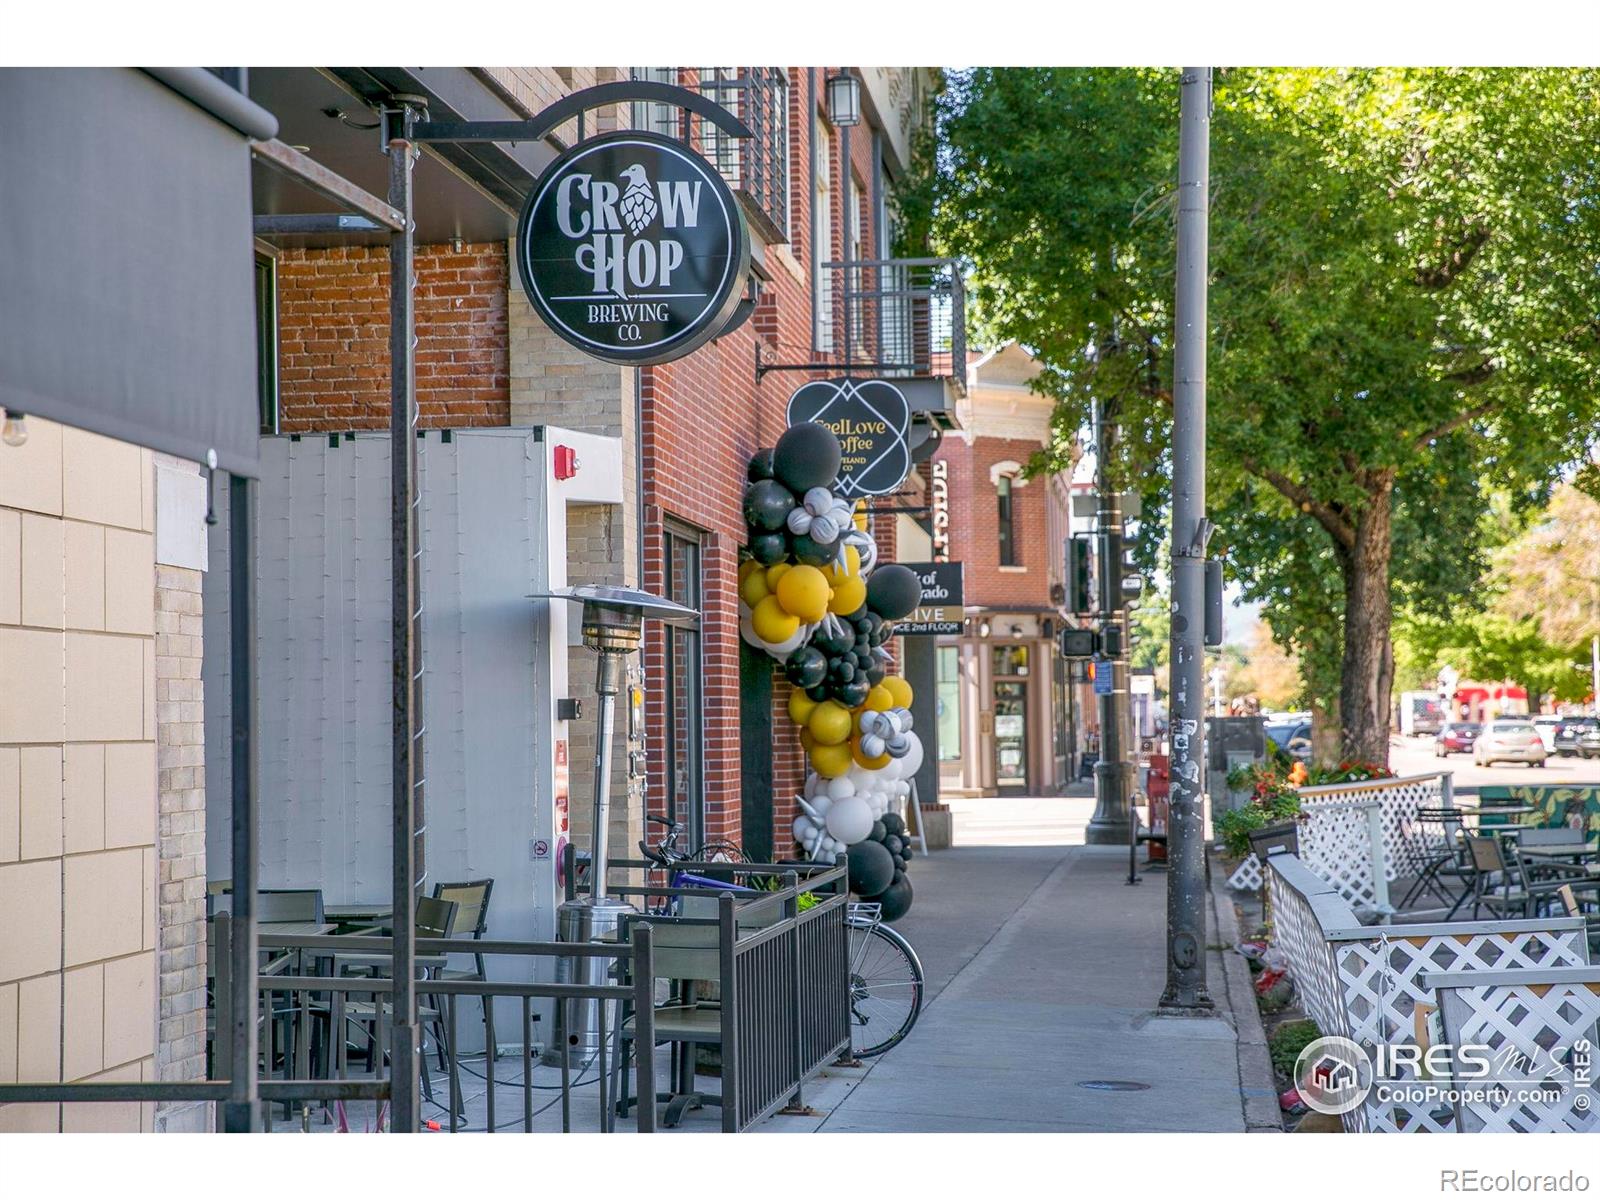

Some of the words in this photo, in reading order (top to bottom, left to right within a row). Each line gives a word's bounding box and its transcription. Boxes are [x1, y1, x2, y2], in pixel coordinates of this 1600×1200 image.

[575, 233, 684, 300] HOP
[588, 303, 669, 323] BREWING
[618, 324, 642, 341] CO.
[840, 436, 873, 453] offee
[922, 571, 937, 585] of
[928, 622, 959, 632] FLOOR
